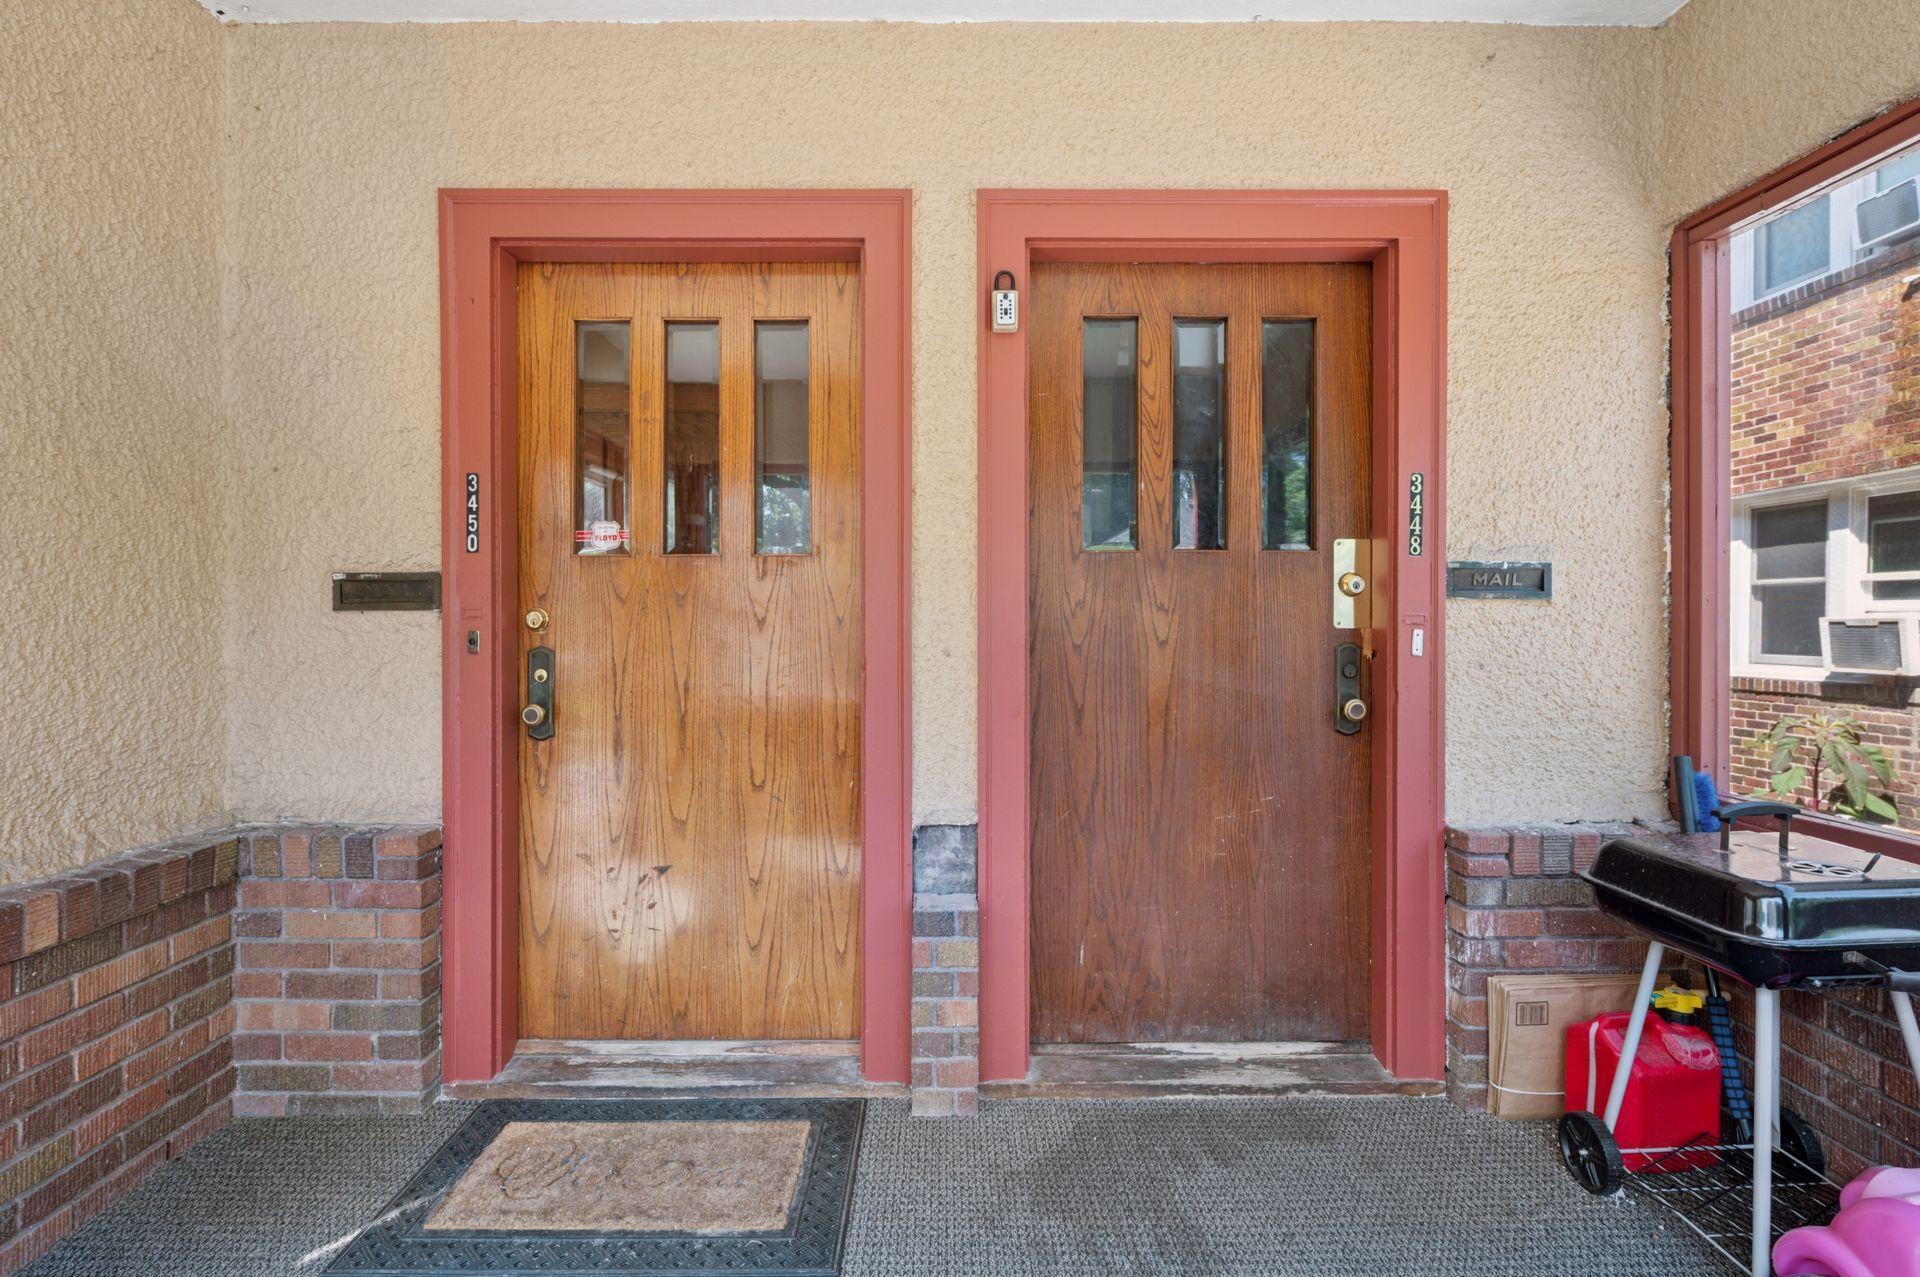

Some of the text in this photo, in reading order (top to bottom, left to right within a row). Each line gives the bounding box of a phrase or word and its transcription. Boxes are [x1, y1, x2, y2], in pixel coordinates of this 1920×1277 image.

[467, 474, 478, 552] 3450
[1410, 474, 1423, 555] 3448
[594, 534, 618, 542] FLOYD
[1472, 572, 1523, 586] MAIL
